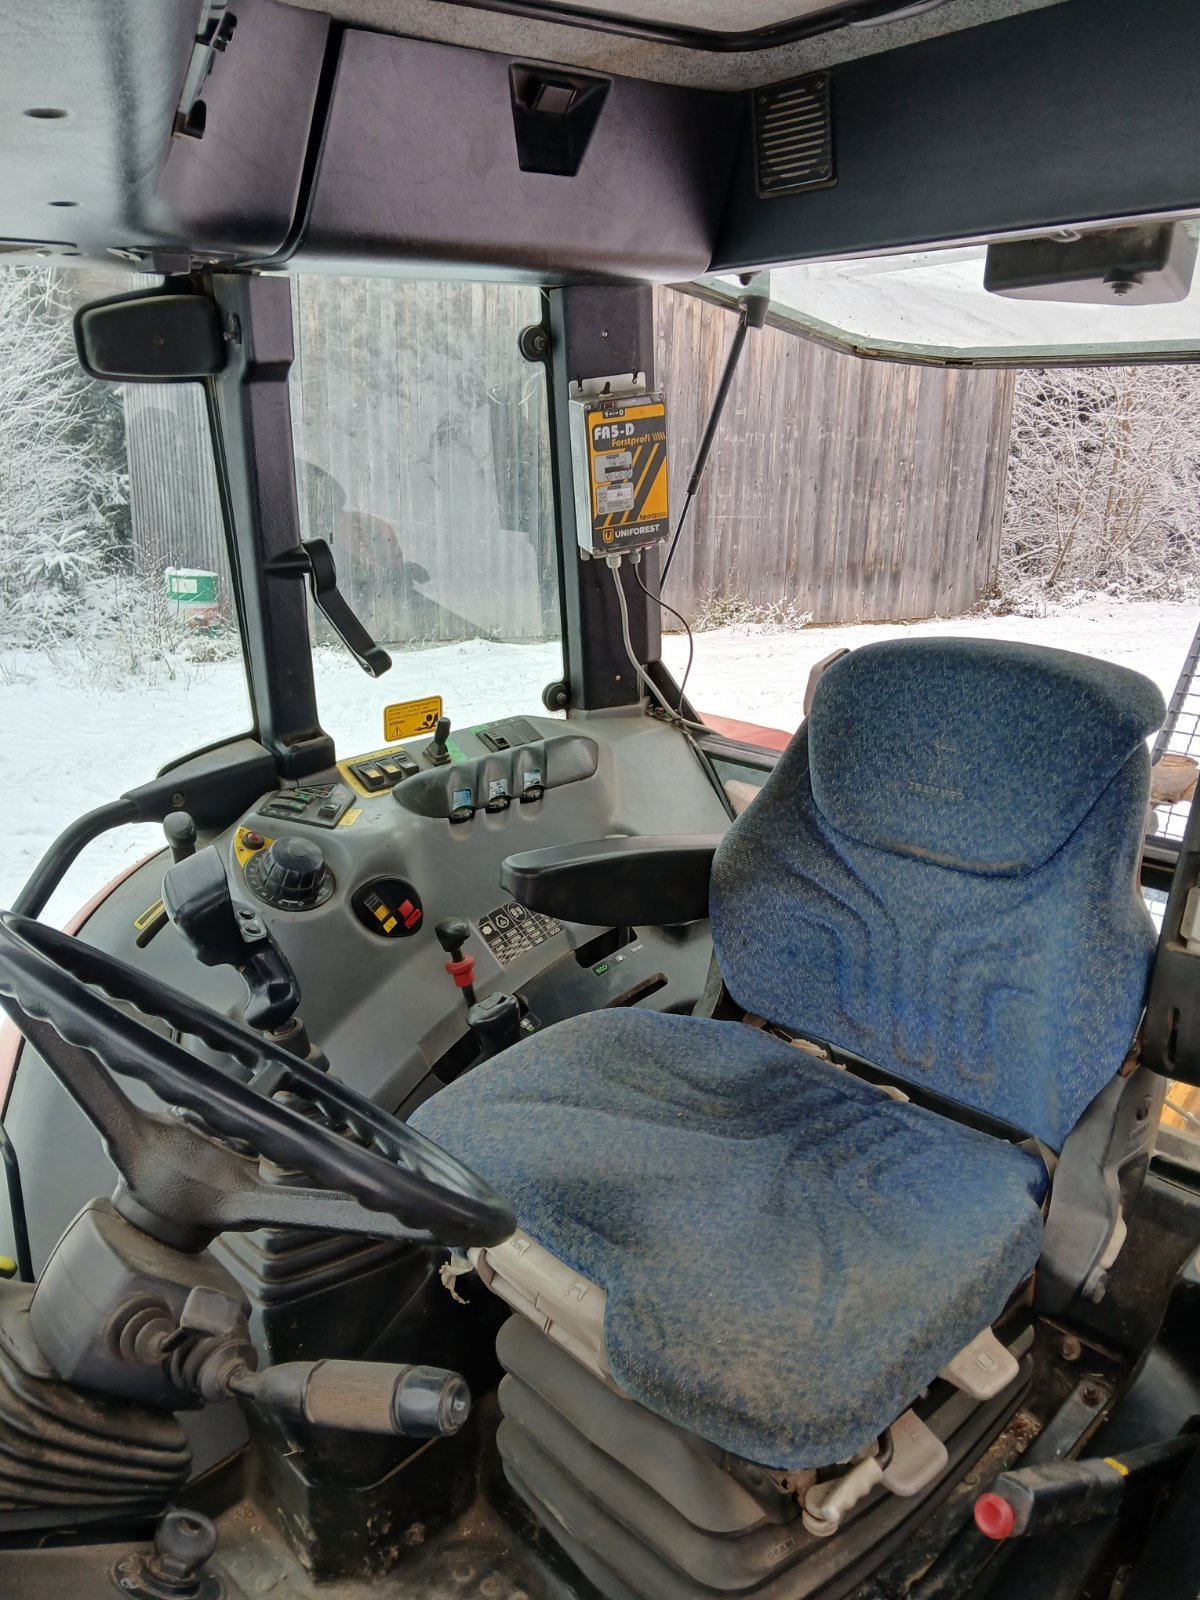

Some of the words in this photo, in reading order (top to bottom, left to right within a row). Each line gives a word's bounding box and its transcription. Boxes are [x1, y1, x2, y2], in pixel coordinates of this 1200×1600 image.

[594, 422, 635, 440] FA5-D
[611, 433, 651, 447] Forstprofi
[615, 524, 660, 538] UNIFOREST
[596, 964, 608, 974] ECO
